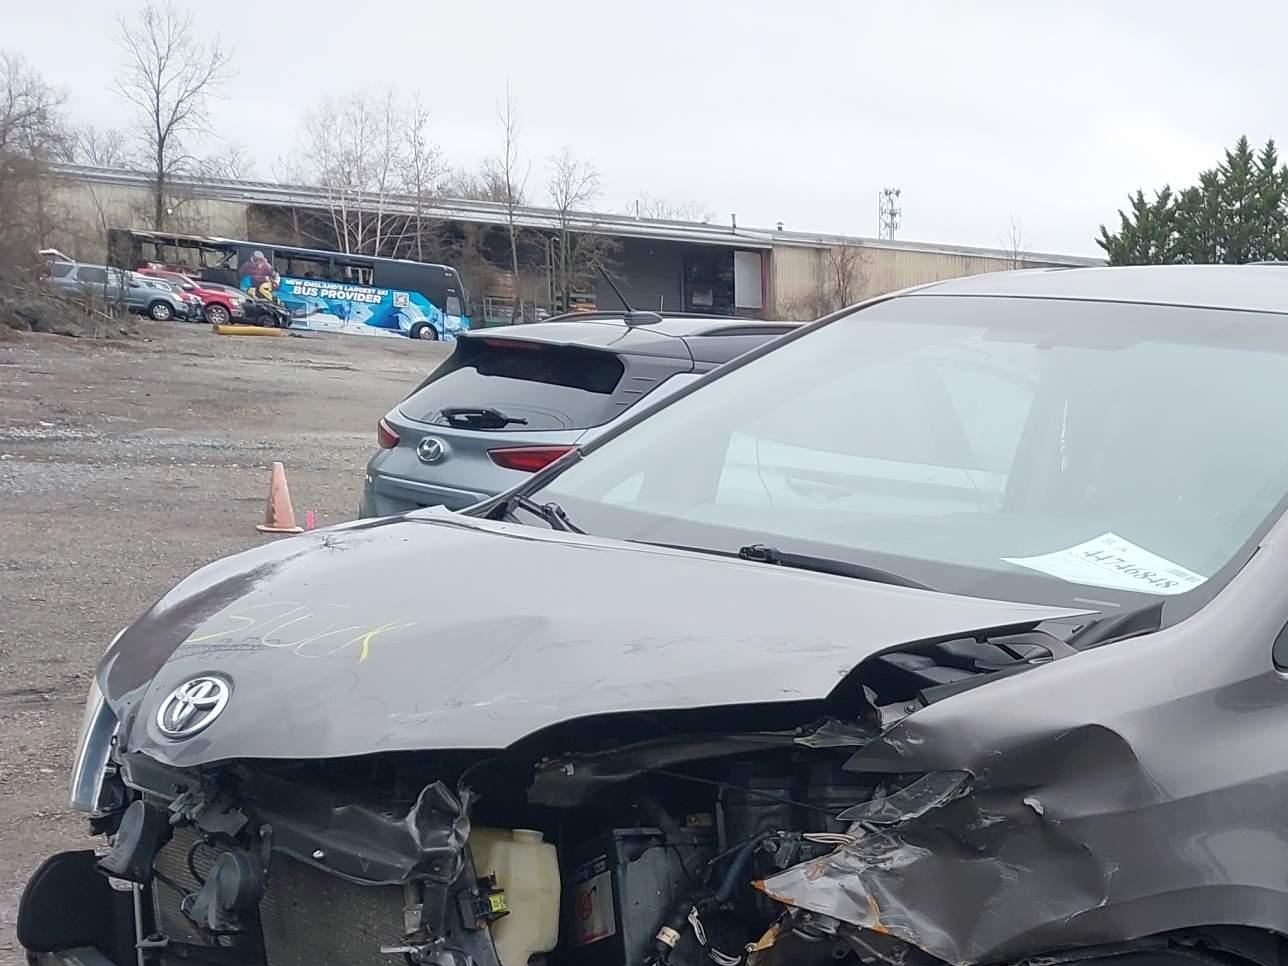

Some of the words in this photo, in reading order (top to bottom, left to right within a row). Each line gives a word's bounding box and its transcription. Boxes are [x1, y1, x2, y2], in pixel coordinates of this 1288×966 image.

[285, 279, 301, 287] NEW
[303, 281, 344, 291] ENGLAND'S
[344, 285, 376, 294] LARGEST
[293, 286, 318, 297] BUS
[320, 289, 382, 304] PROVIDER
[1083, 550, 1179, 588] 44746848
